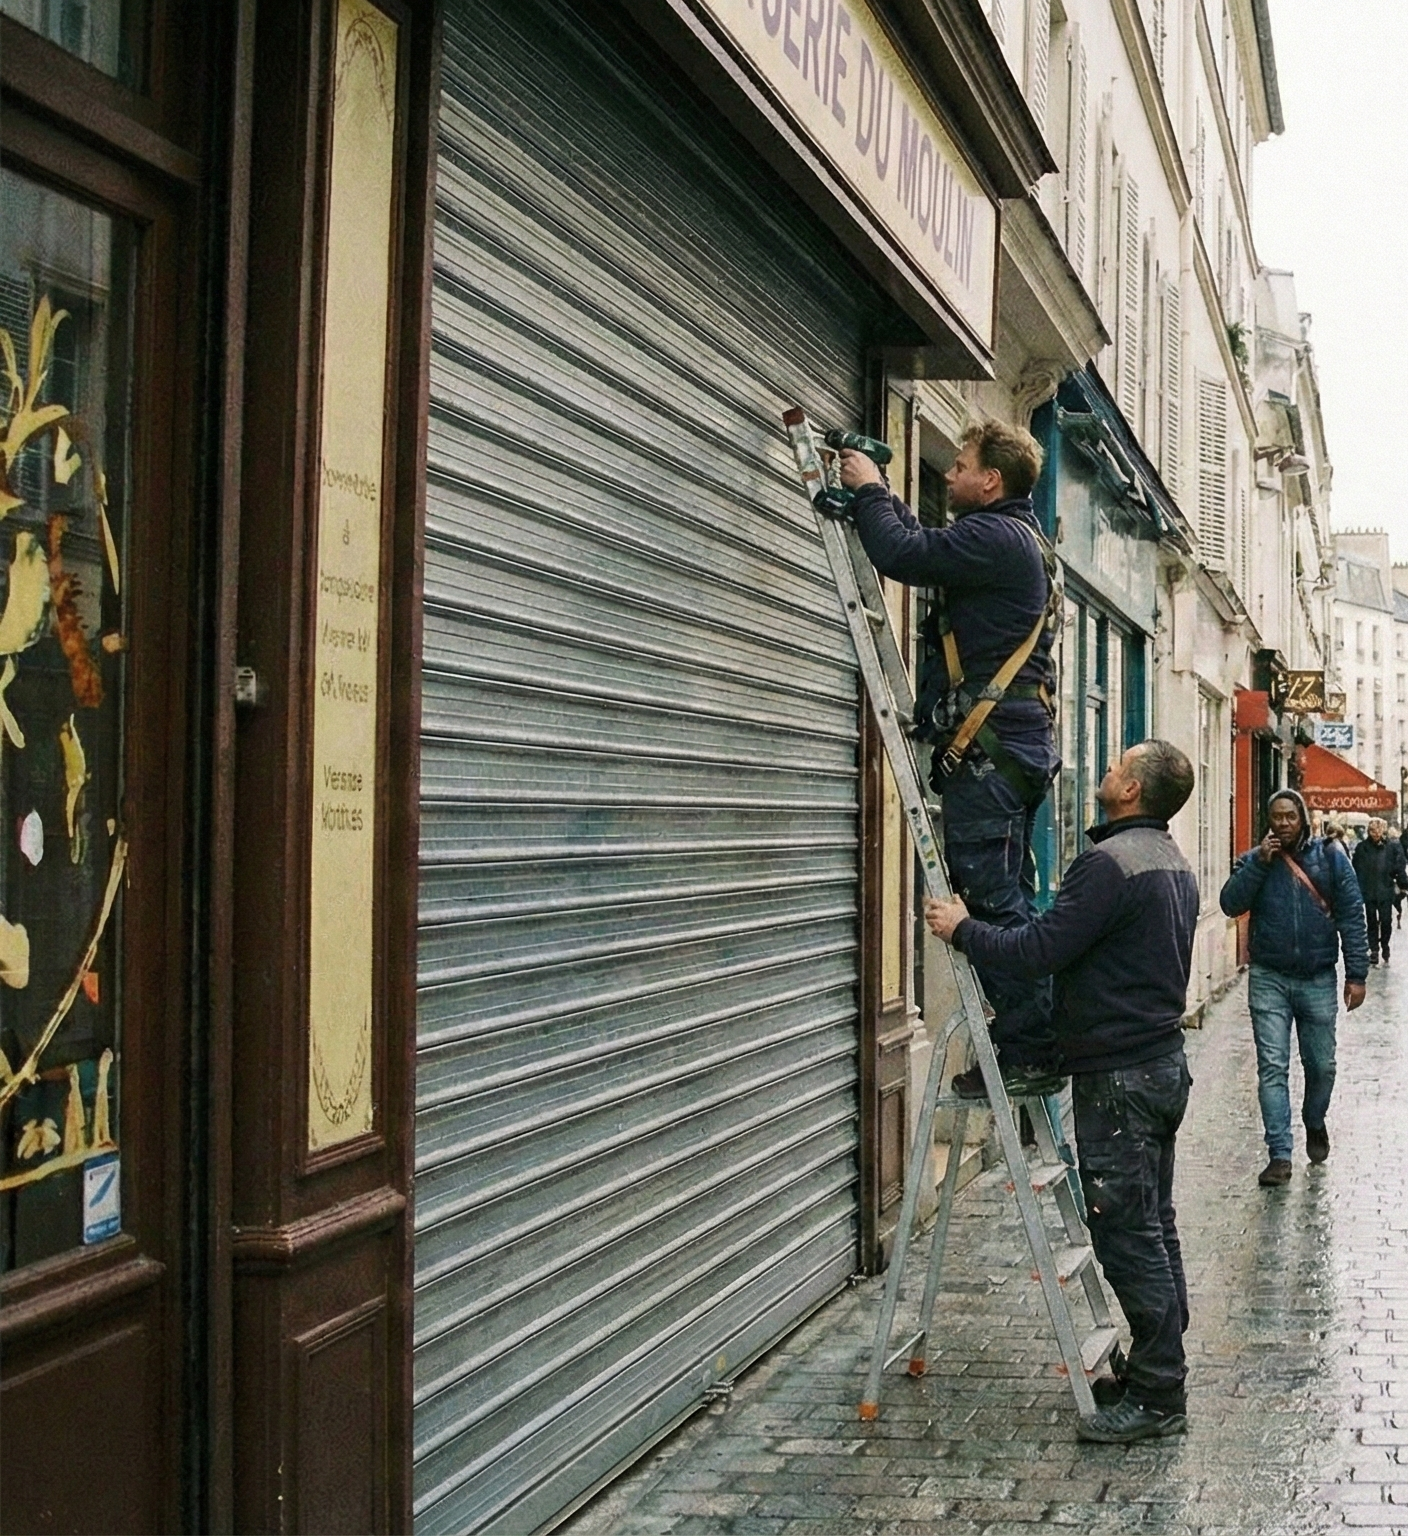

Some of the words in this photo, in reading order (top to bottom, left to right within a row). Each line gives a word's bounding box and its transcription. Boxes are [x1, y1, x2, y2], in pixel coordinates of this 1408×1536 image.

[747, 0, 851, 129] ERIE
[855, 38, 893, 182] DU
[897, 102, 975, 292] MOULIN
